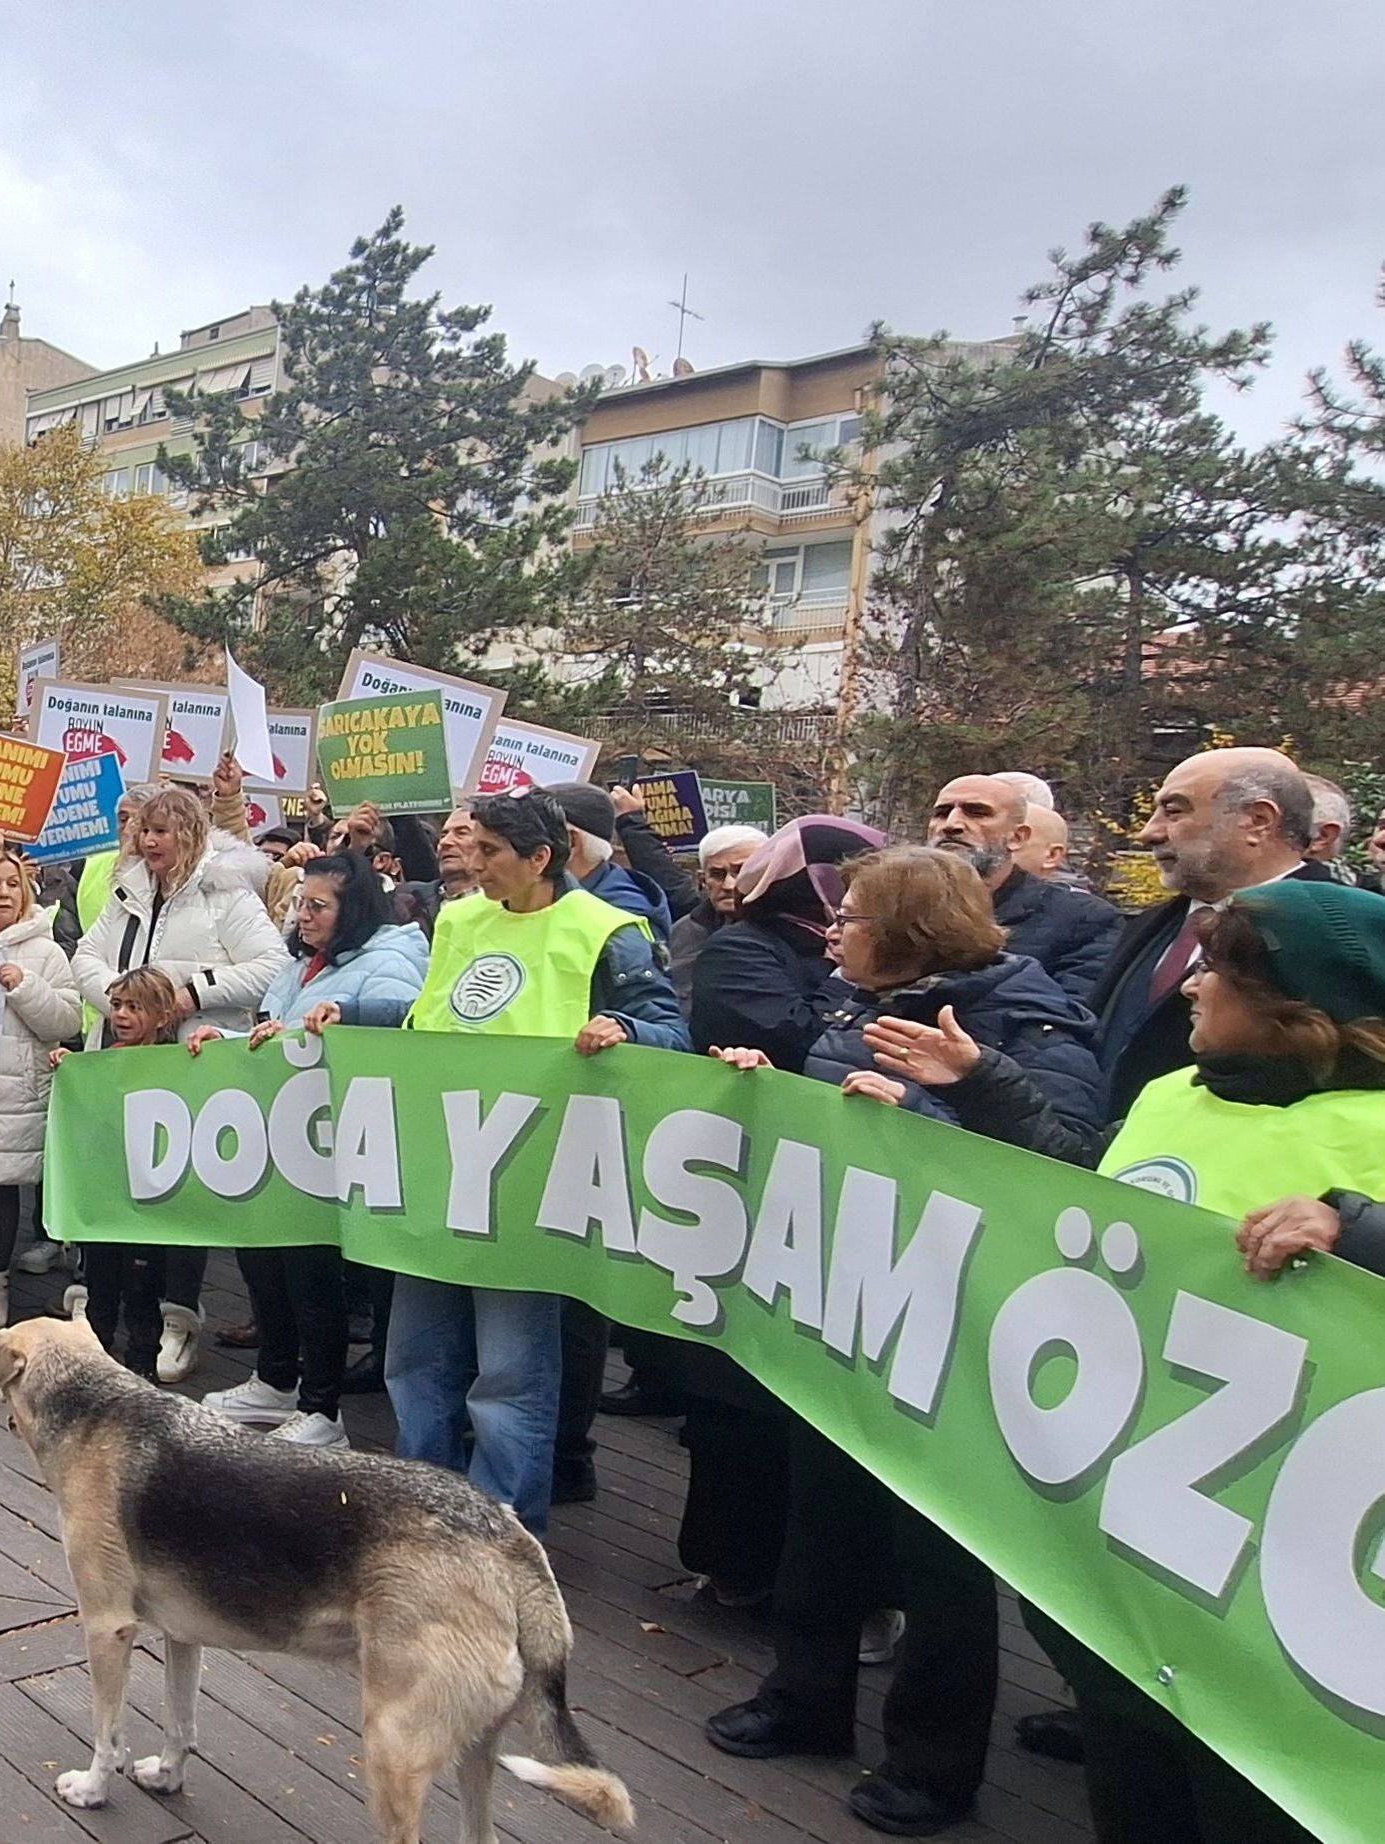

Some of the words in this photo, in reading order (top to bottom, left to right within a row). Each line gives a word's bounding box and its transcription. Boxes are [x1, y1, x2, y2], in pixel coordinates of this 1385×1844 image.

[48, 696, 99, 715] Doğanın
[103, 704, 153, 722] talanına
[173, 701, 221, 717] talanına
[319, 702, 442, 739] SARICAKAYA
[444, 699, 483, 720] anına
[68, 717, 104, 734] BOYUN
[267, 723, 307, 737] alanına
[347, 730, 389, 757] YOK
[526, 741, 579, 766] talanına
[331, 750, 424, 782] OLMASIN!
[488, 750, 525, 768] BOYUN
[46, 800, 99, 827] ADENE
[38, 816, 110, 848] VERMEM!
[124, 1037, 403, 1210] DOĞA
[443, 1089, 982, 1413] YAŞAM
